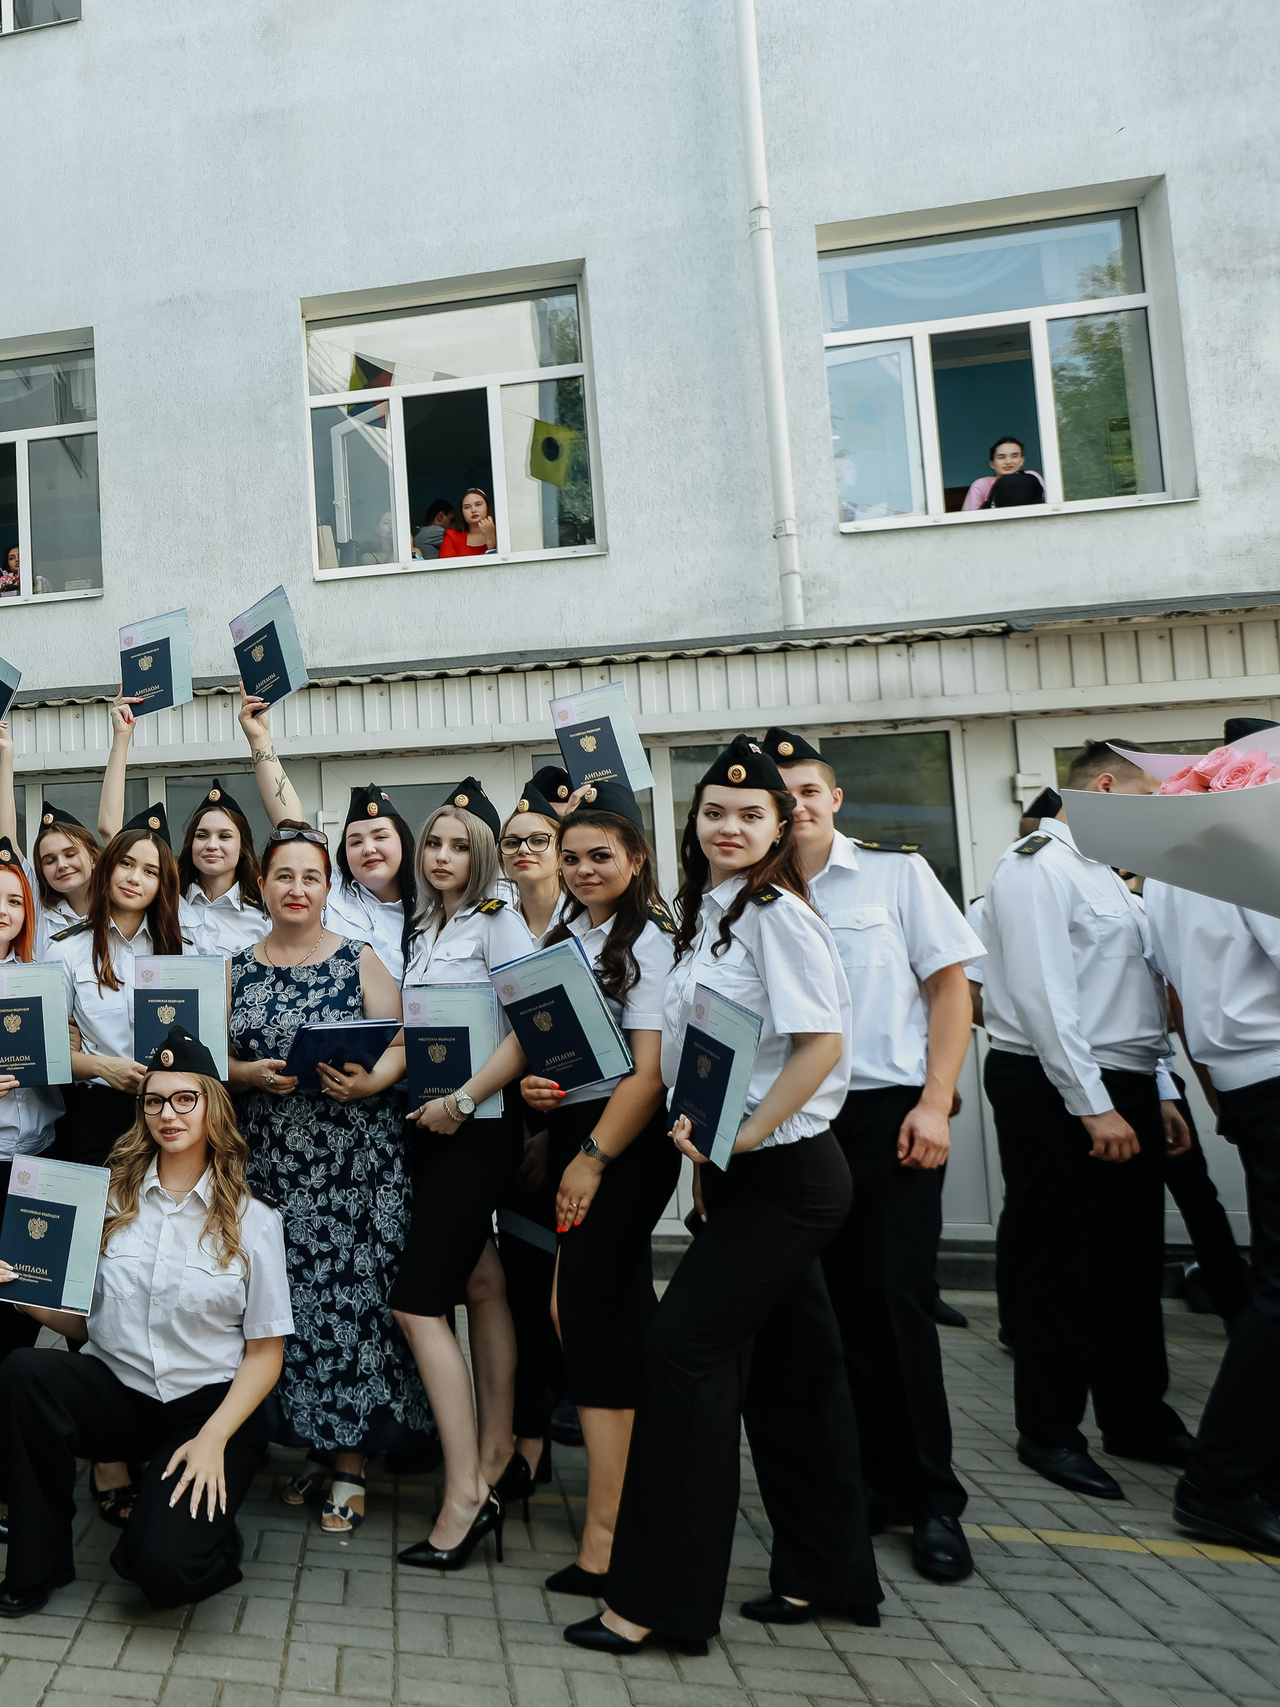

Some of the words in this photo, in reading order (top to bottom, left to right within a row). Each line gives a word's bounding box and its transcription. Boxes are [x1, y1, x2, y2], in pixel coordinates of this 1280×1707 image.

[255, 673, 276, 690] ДИПЛОМ
[134, 685, 160, 696] ДИПЛОМ
[584, 768, 612, 780] ДИПЛОМ
[0, 1055, 31, 1064] ДИПЛОМ
[545, 1050, 576, 1066] ДИПЛОМ
[13, 1263, 48, 1276] ДИПЛОМ
